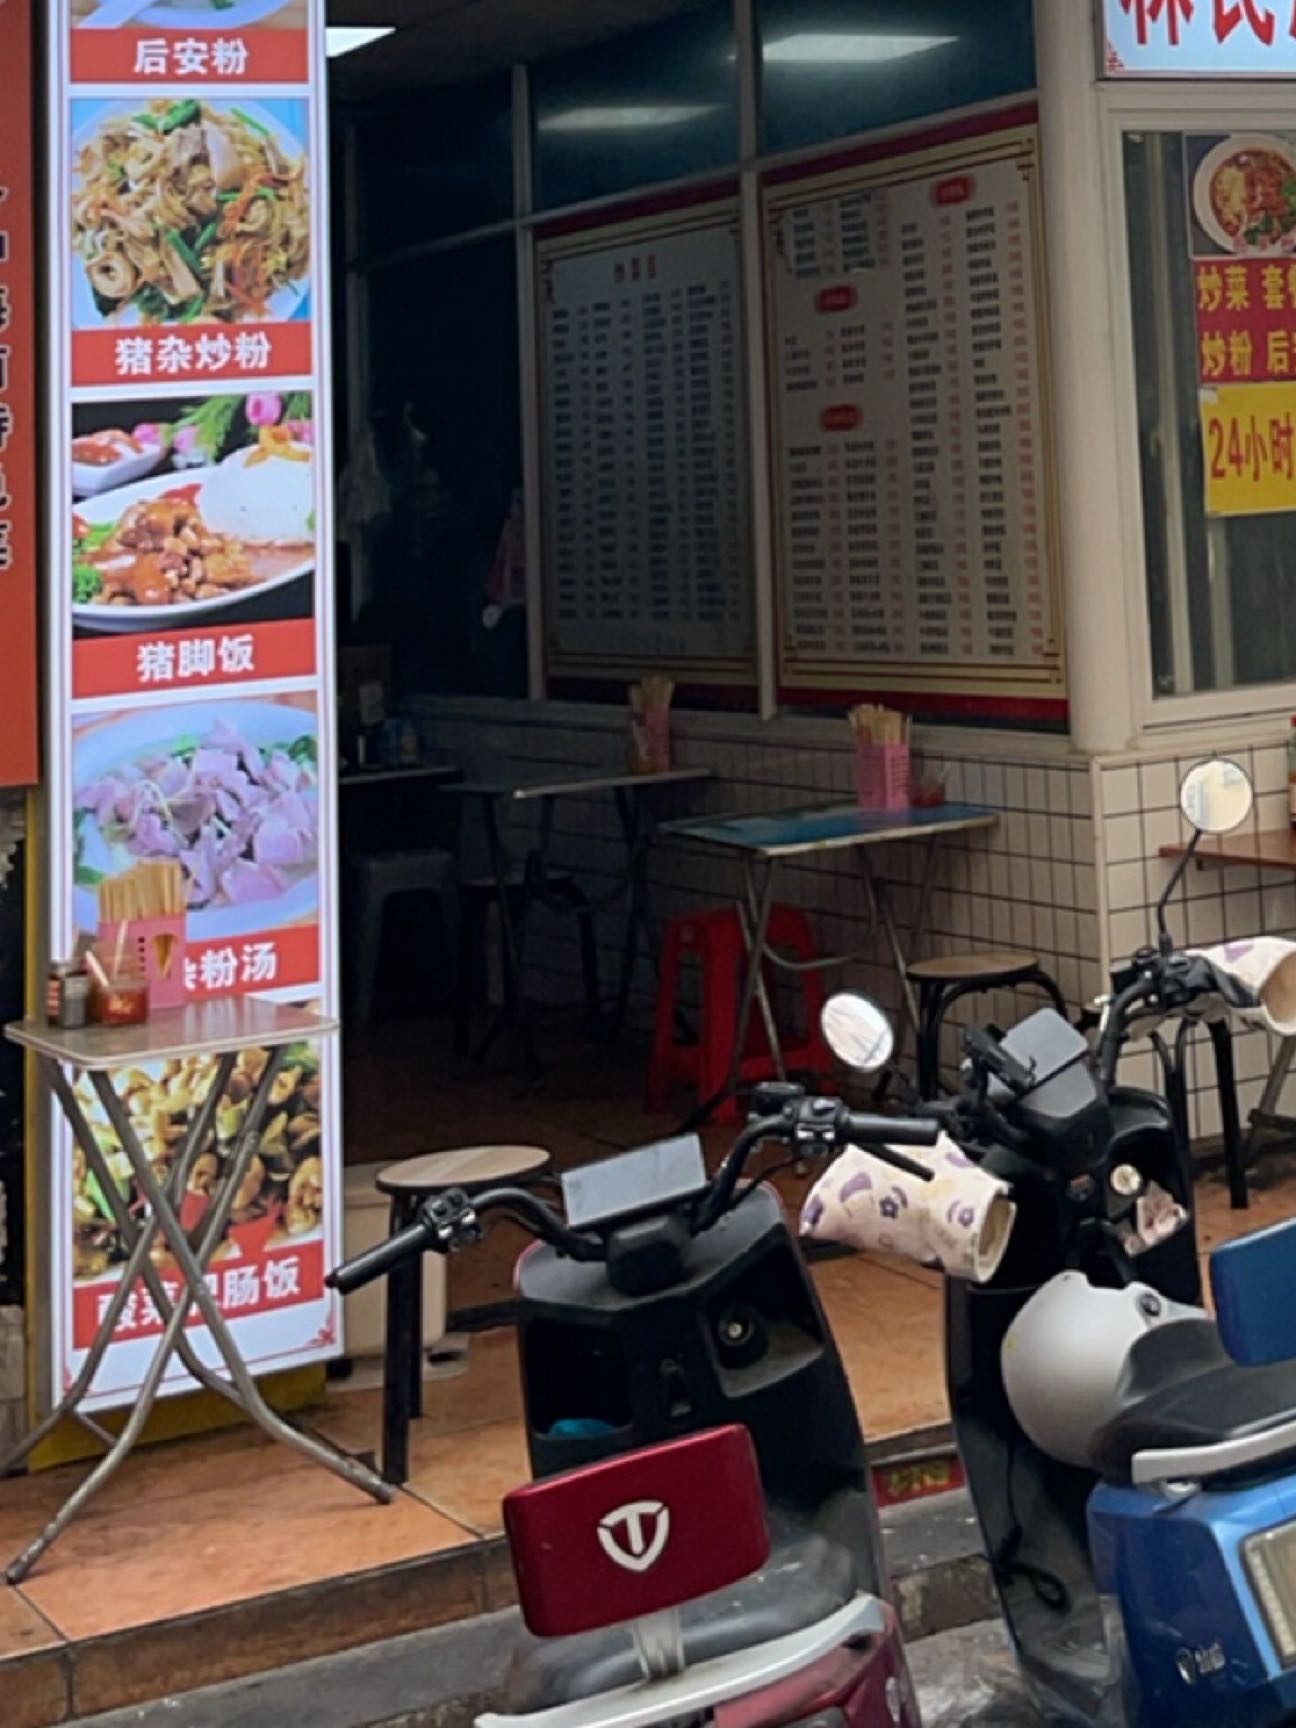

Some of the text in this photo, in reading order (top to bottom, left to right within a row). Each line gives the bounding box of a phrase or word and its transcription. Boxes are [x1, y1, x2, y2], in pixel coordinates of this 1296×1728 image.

[133, 36, 249, 75] 后安粉
[1198, 266, 1251, 311] 炒菜
[114, 330, 273, 376] 猪杂炒粉
[1201, 331, 1253, 377] 炒粉
[136, 635, 256, 682] 猪脚饭
